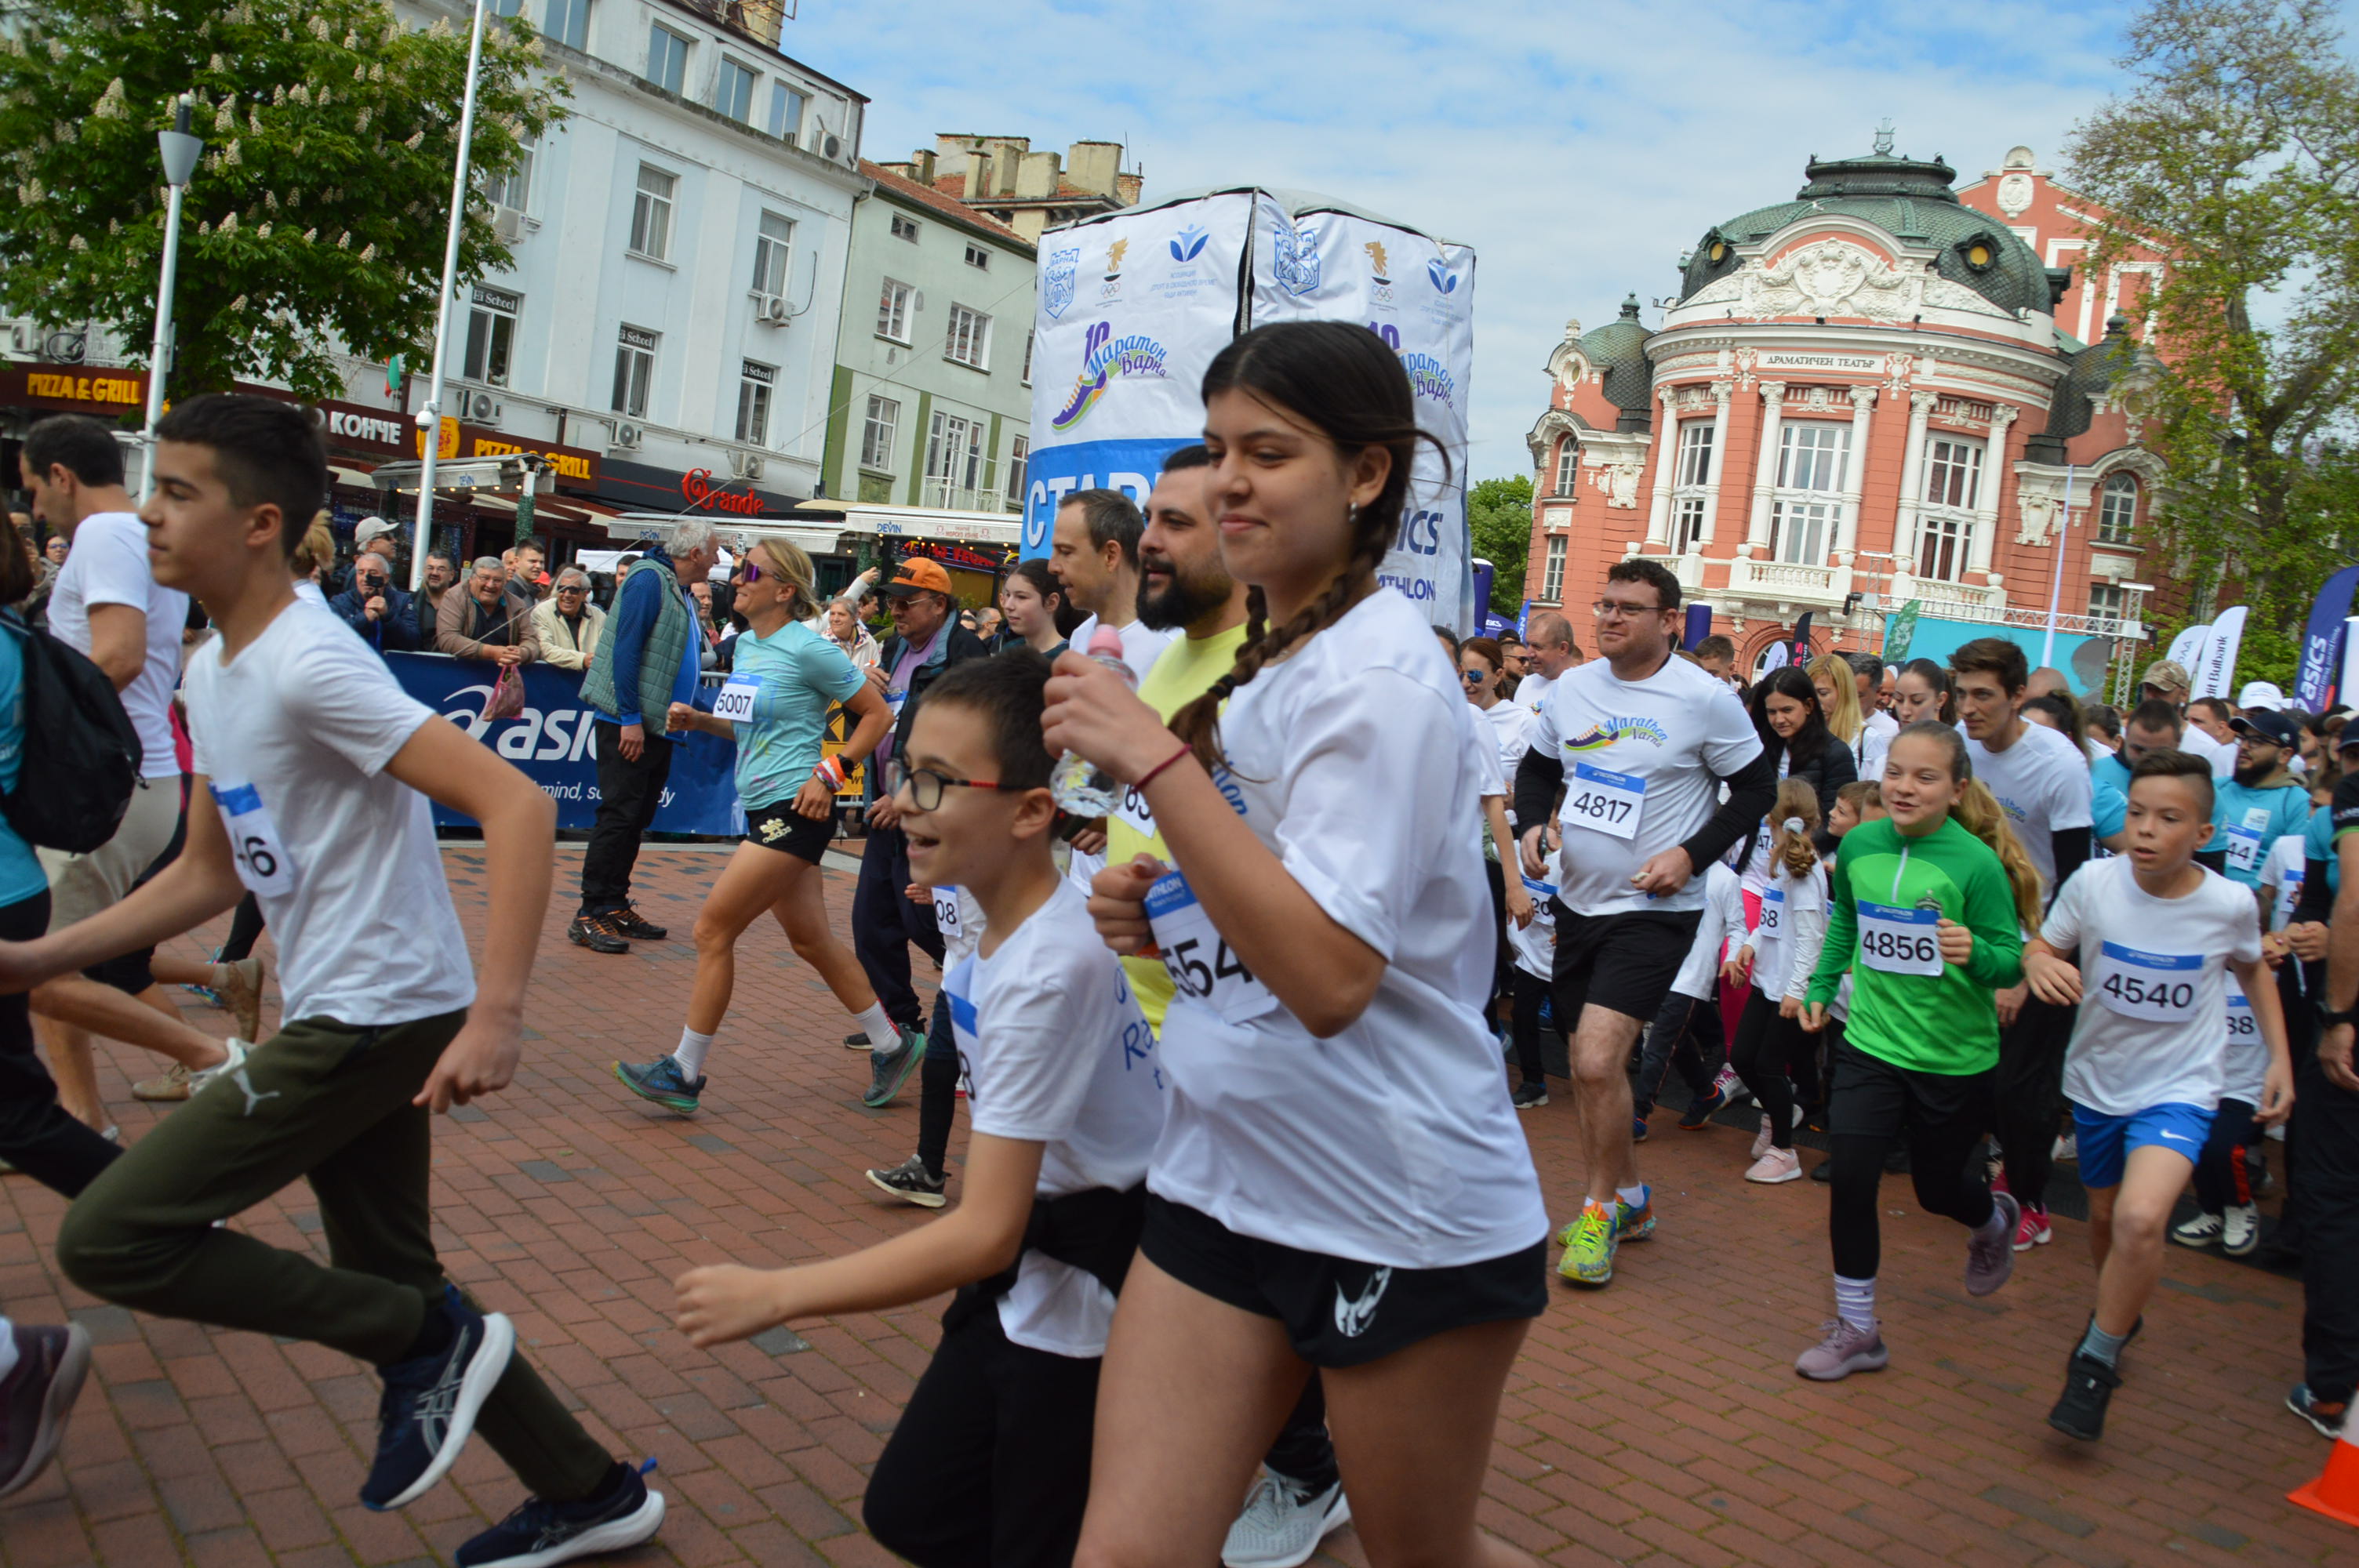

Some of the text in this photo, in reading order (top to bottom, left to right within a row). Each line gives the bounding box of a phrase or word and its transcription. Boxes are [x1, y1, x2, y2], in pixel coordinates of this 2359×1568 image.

[485, 293, 515, 310] School
[627, 332, 652, 347] School
[749, 366, 772, 380] School
[1088, 335, 1167, 382] Маратон
[1118, 352, 1167, 377] Варна
[1399, 353, 1454, 392] ратон
[1767, 355, 1875, 368] ДРАМАТИЧЕН ТЕАТЪР
[27, 373, 142, 405] PIZZA & GRILL
[1413, 371, 1453, 408] Варна
[329, 411, 402, 445] КОНЧЕ
[544, 452, 591, 480] GRILL
[682, 467, 765, 516] Grande
[877, 521, 902, 534] DEVIN
[1397, 507, 1444, 556] ICS
[2208, 636, 2228, 681] Bulbank
[2300, 635, 2327, 701] asics
[717, 693, 751, 716] 5007
[496, 707, 598, 762] asi
[1604, 717, 1668, 741] Marathon
[1573, 792, 1633, 824] 4817
[935, 899, 957, 925] 08
[1530, 897, 1551, 916] 20
[1863, 930, 1935, 962] 4856
[2103, 973, 2194, 1008] 4540
